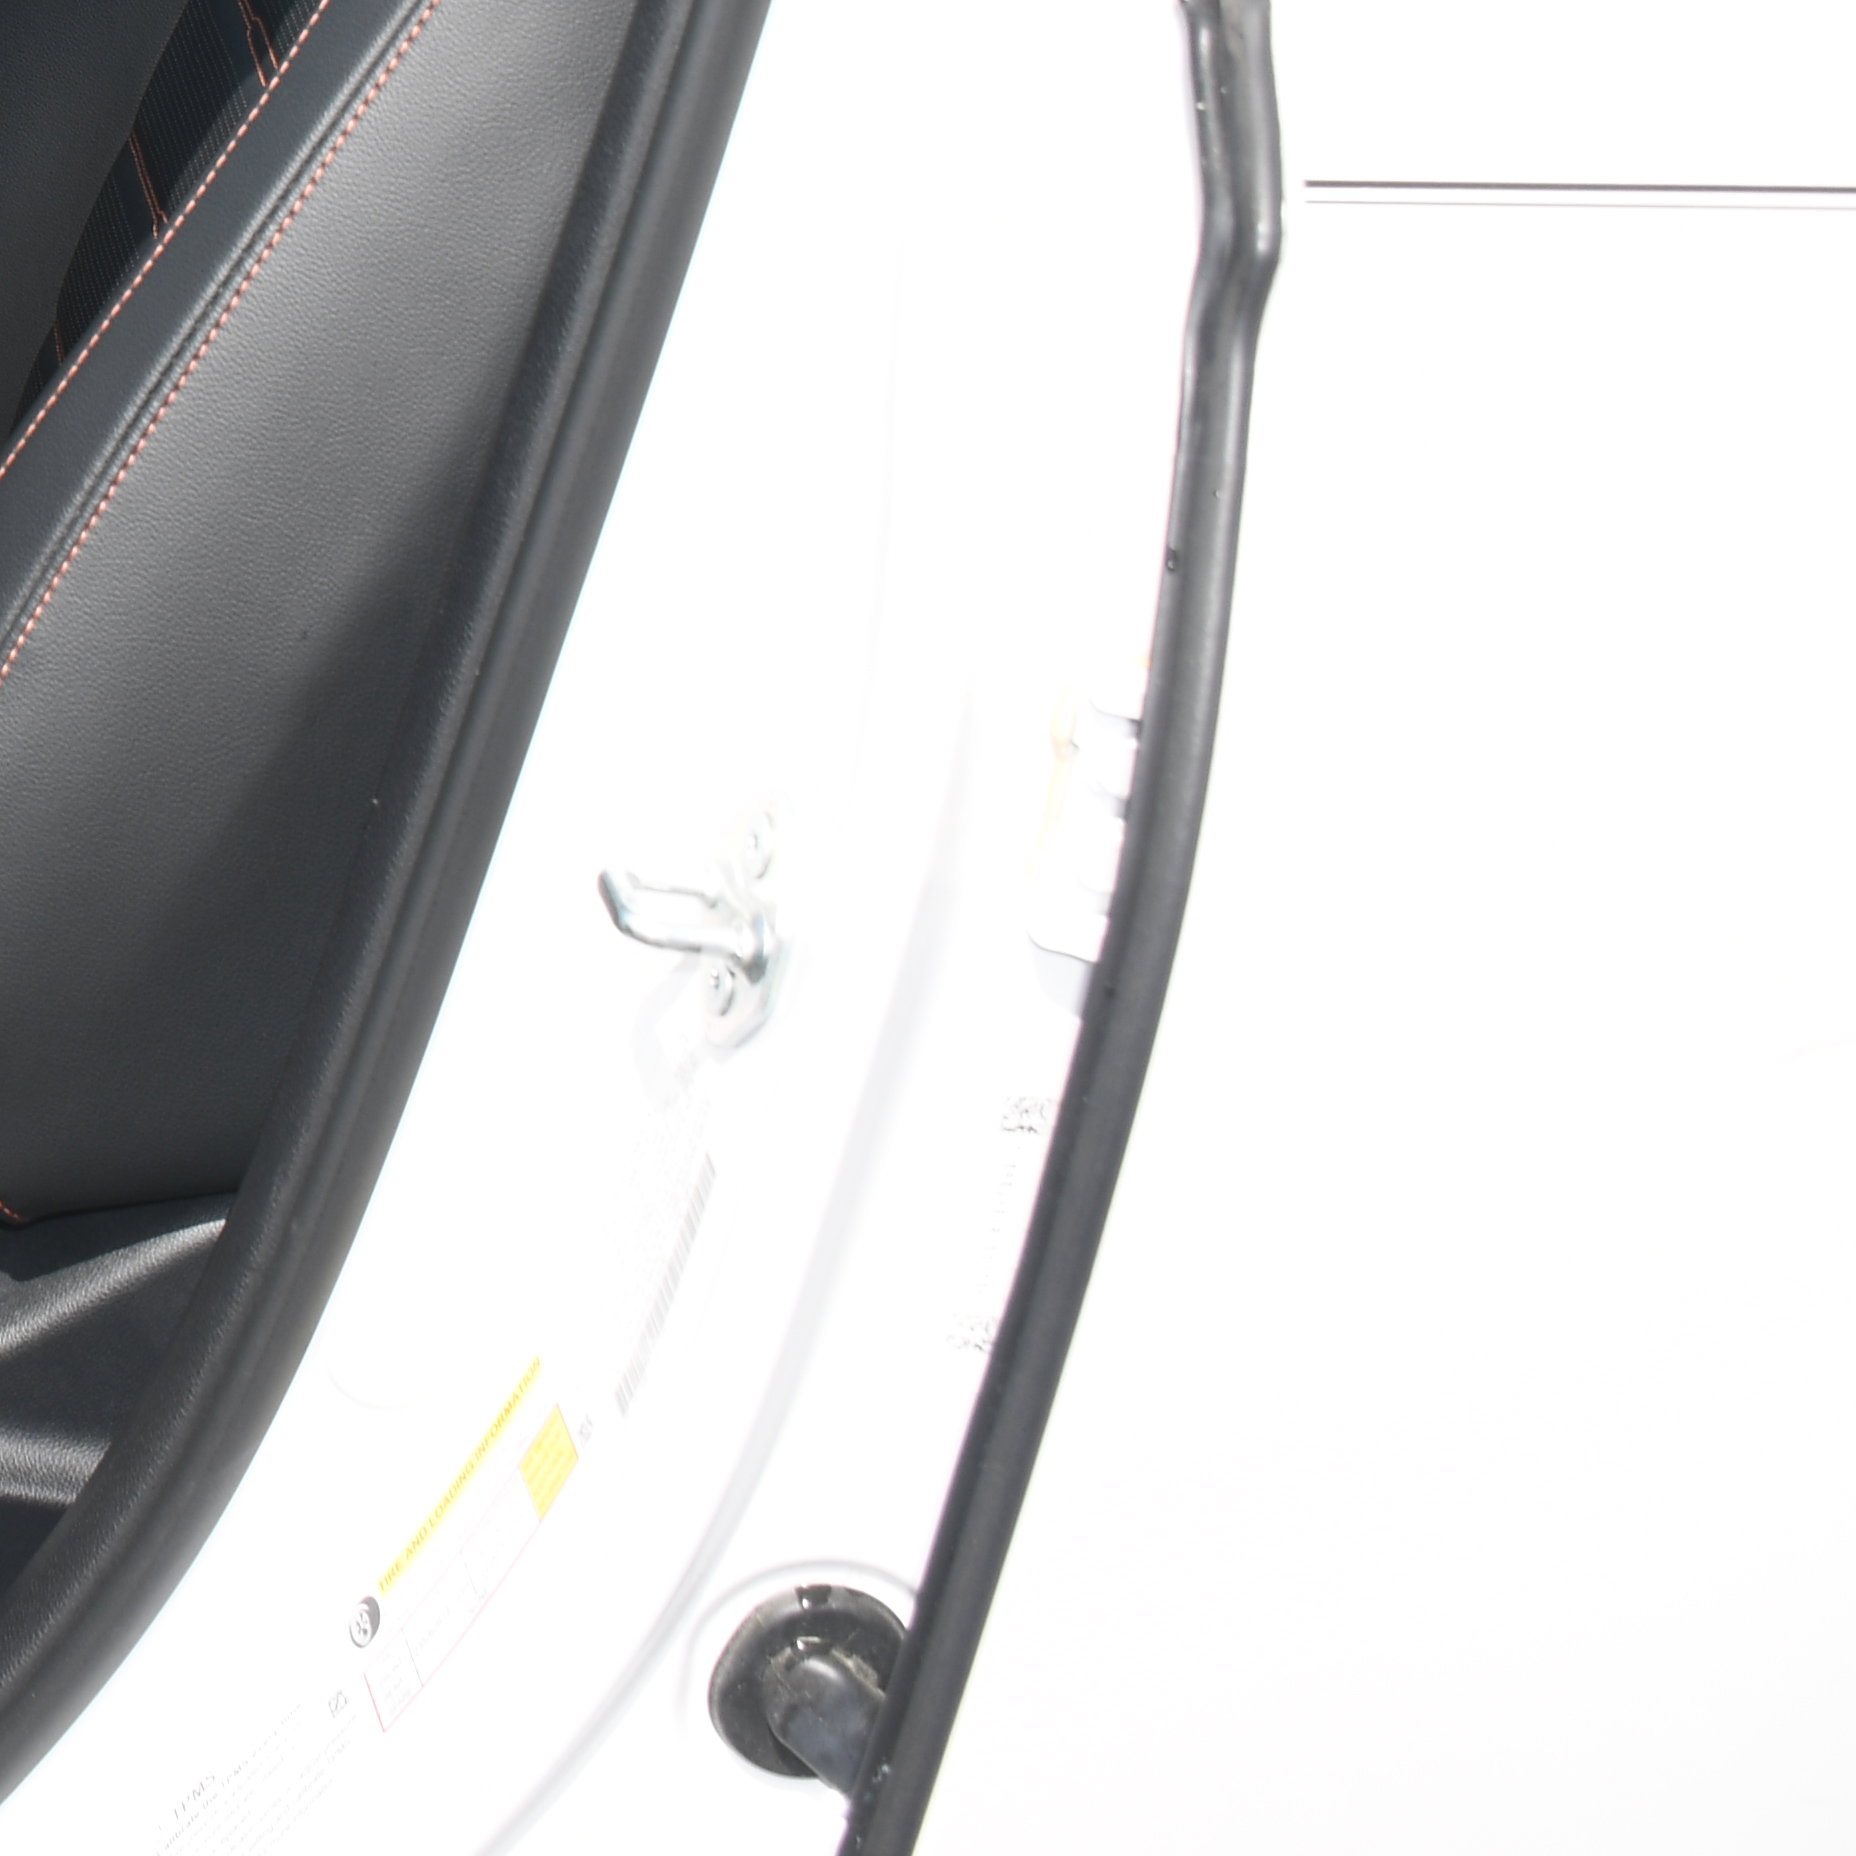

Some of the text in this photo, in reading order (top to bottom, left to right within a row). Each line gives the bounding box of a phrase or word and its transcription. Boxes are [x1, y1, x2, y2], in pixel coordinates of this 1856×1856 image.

[378, 1355, 542, 1592] TIRE AND LOADING INFORMATION
